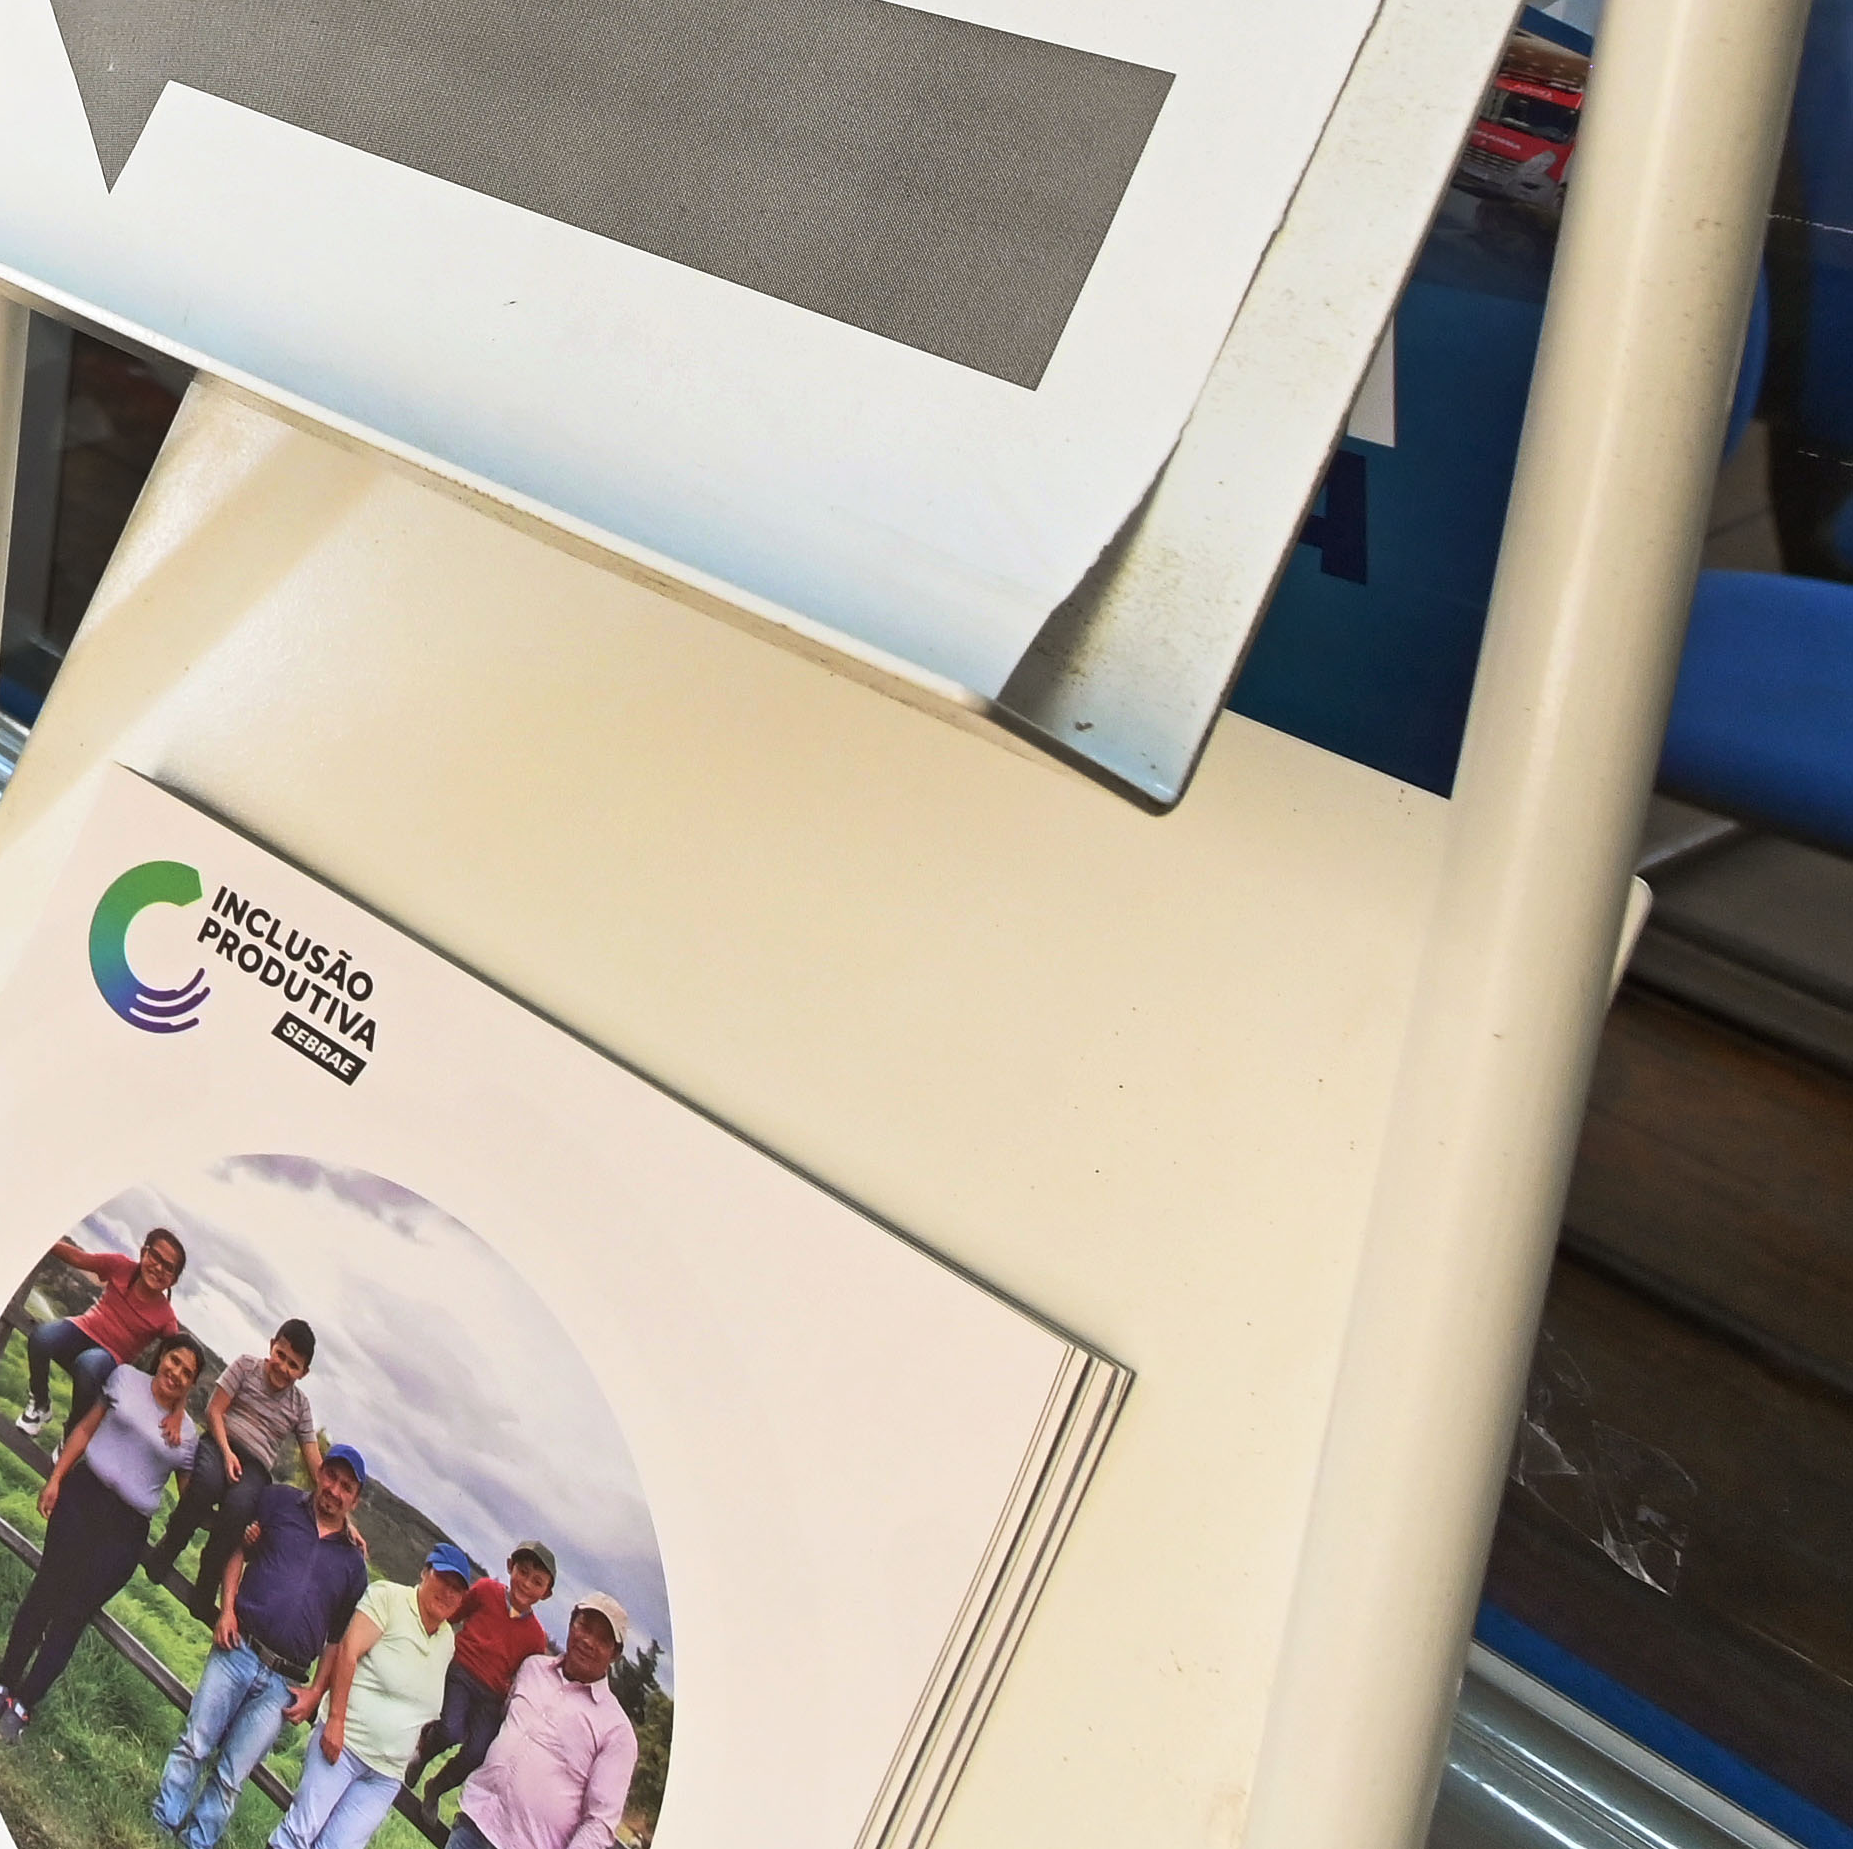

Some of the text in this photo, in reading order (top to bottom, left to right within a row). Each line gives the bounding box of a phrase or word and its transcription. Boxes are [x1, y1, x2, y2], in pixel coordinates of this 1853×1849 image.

[197, 916, 378, 1053] PRODUTIVA
[212, 885, 374, 1002] INCLUSÃO
[282, 1021, 357, 1077] SEBRAE
